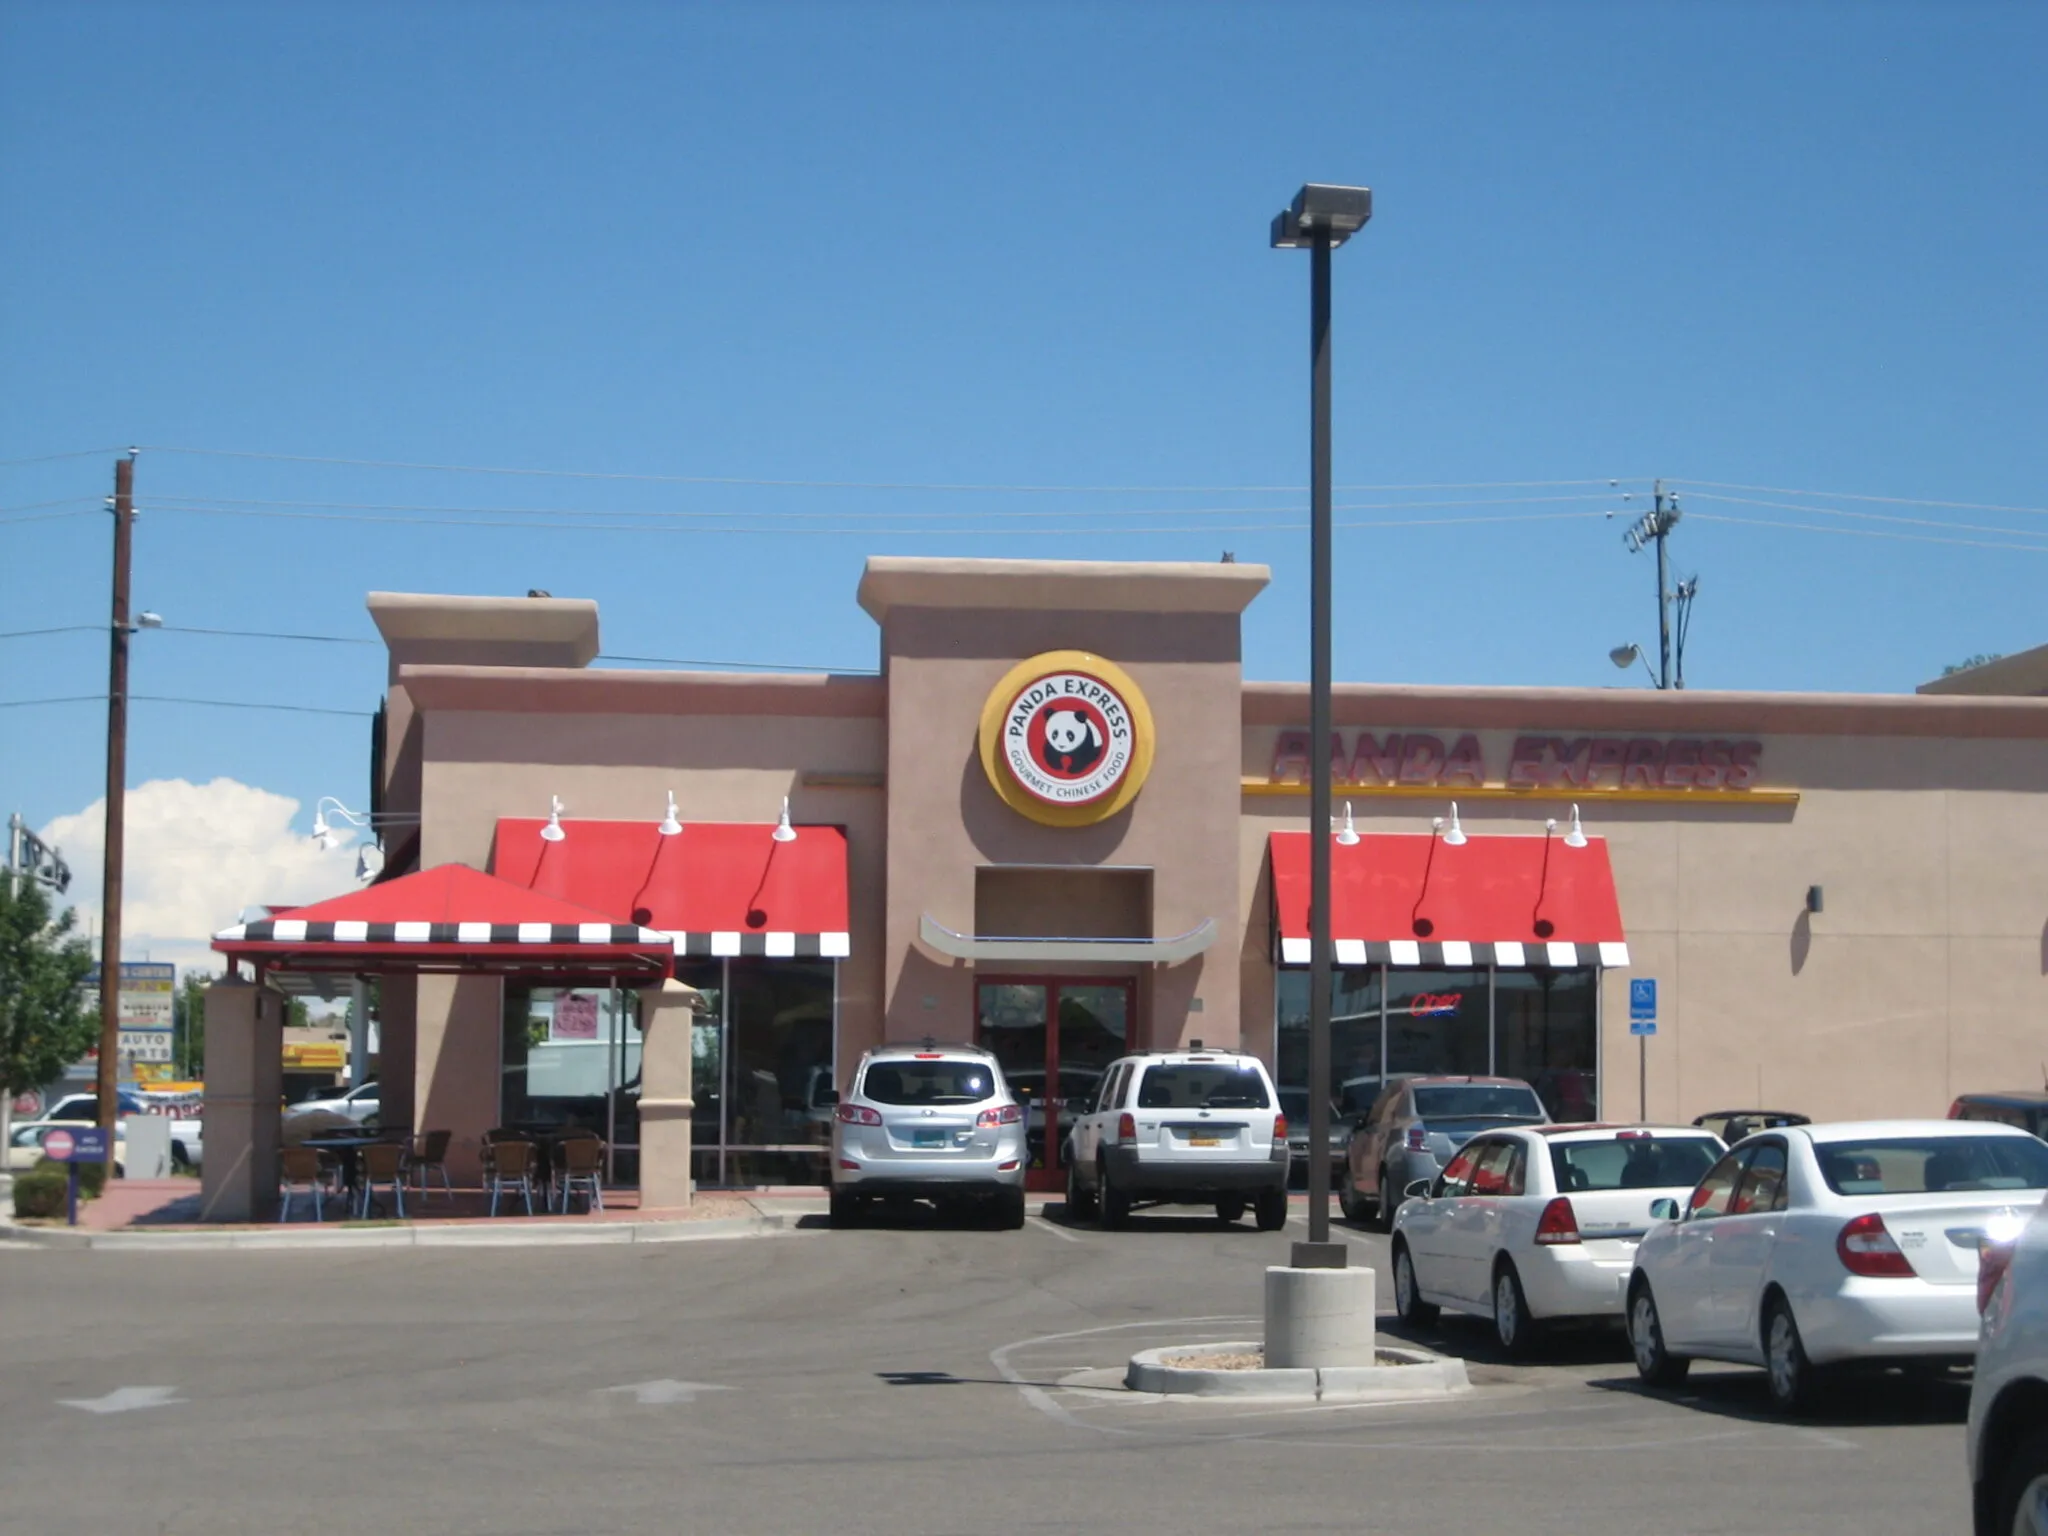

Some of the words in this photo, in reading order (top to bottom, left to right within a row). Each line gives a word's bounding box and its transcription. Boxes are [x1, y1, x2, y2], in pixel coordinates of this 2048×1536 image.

[1009, 682, 1058, 737] PANDA
[1064, 679, 1128, 739] EXPRESS
[1010, 749, 1053, 794] GOURMET
[1056, 780, 1103, 799] CHINESE
[1104, 751, 1126, 782] FOOD
[1507, 735, 1764, 791] EXPRESS
[122, 1034, 165, 1046] AUTO
